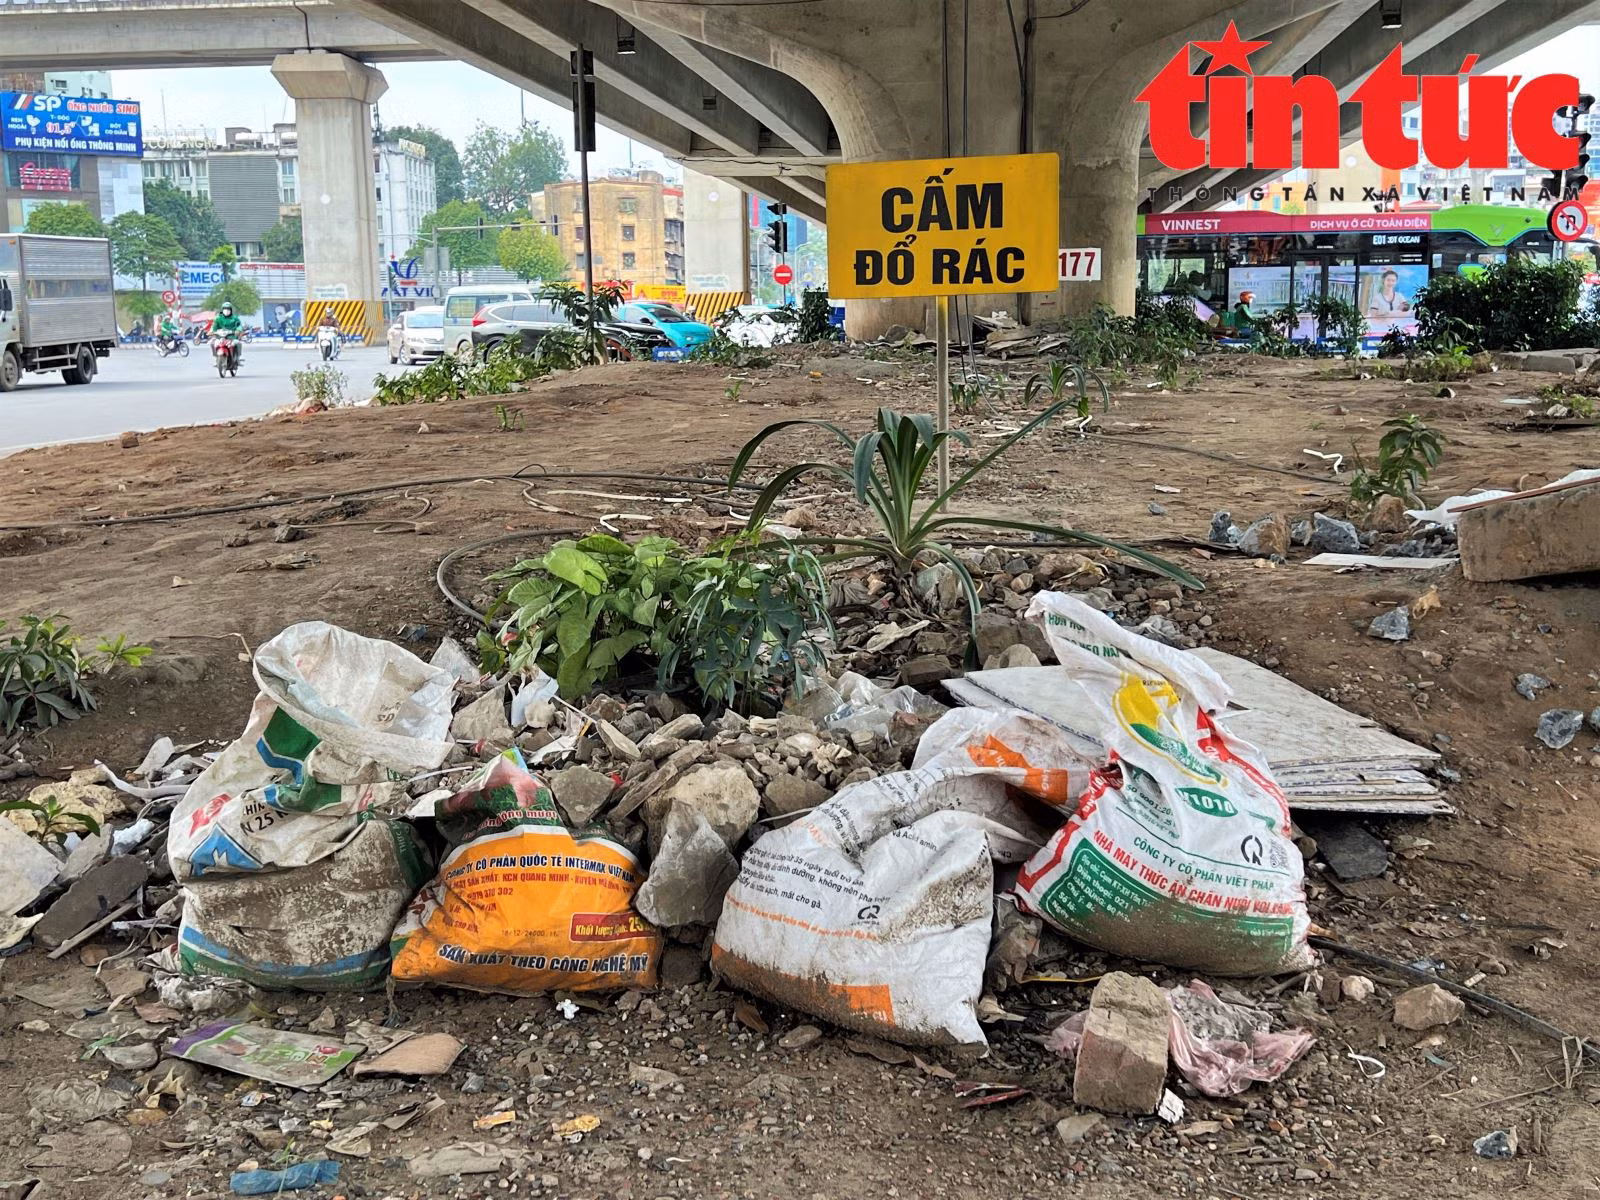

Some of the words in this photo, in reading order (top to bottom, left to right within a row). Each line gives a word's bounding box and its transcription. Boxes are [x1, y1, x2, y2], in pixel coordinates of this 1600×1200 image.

[33, 95, 62, 112] SP
[15, 137, 32, 148] PHỤ
[34, 137, 53, 149] KIỆN
[55, 138, 68, 149] NỐI
[71, 138, 87, 149] ỐNG
[88, 139, 114, 151] THÔNG
[116, 143, 137, 151] MINH
[881, 168, 1004, 233] CẤM
[1161, 219, 1222, 231] VINNEST
[1310, 220, 1334, 231] DỊCH
[1335, 220, 1350, 231] VỤ
[1376, 218, 1402, 229] TOÀN
[1403, 218, 1428, 229] DIỆN
[854, 234, 914, 285] ĐỔ
[932, 238, 1025, 285] RÁC
[1059, 251, 1096, 277] 177
[255, 812, 275, 831] 25
[475, 857, 488, 871] CỔ
[489, 855, 517, 868] PHẦN
[519, 854, 548, 867] QUỐC
[551, 854, 563, 867] TẾ
[565, 857, 606, 874] INTERMAX
[793, 855, 804, 864] 35
[804, 861, 824, 874] ngày
[1093, 830, 1112, 853] NHÀ
[1113, 847, 1137, 870] MÁY
[1139, 864, 1169, 890] THỨC
[1168, 877, 1188, 897] ĂN
[1188, 889, 1223, 908] CHĂN
[1133, 836, 1159, 859] CÔNG
[1162, 854, 1176, 867] TY
[1178, 859, 1193, 875] CỔ
[1194, 865, 1223, 883] PHẦN
[1225, 874, 1249, 888] VIỆT
[502, 872, 519, 882] KCN
[520, 872, 548, 882] QUANG
[548, 873, 570, 882] MINH
[780, 889, 795, 900] mát
[795, 893, 810, 905] cho
[818, 877, 843, 893] không
[843, 886, 858, 897] nên
[858, 892, 873, 904] pha
[1058, 891, 1069, 903] Số
[575, 923, 594, 936] Khối
[438, 944, 466, 964] SẢN
[468, 950, 507, 966] XUẤT
[510, 955, 546, 970] THEO
[549, 955, 589, 972] CÔNG
[591, 953, 627, 973] NGHỆ
[629, 951, 649, 973] MỸ
